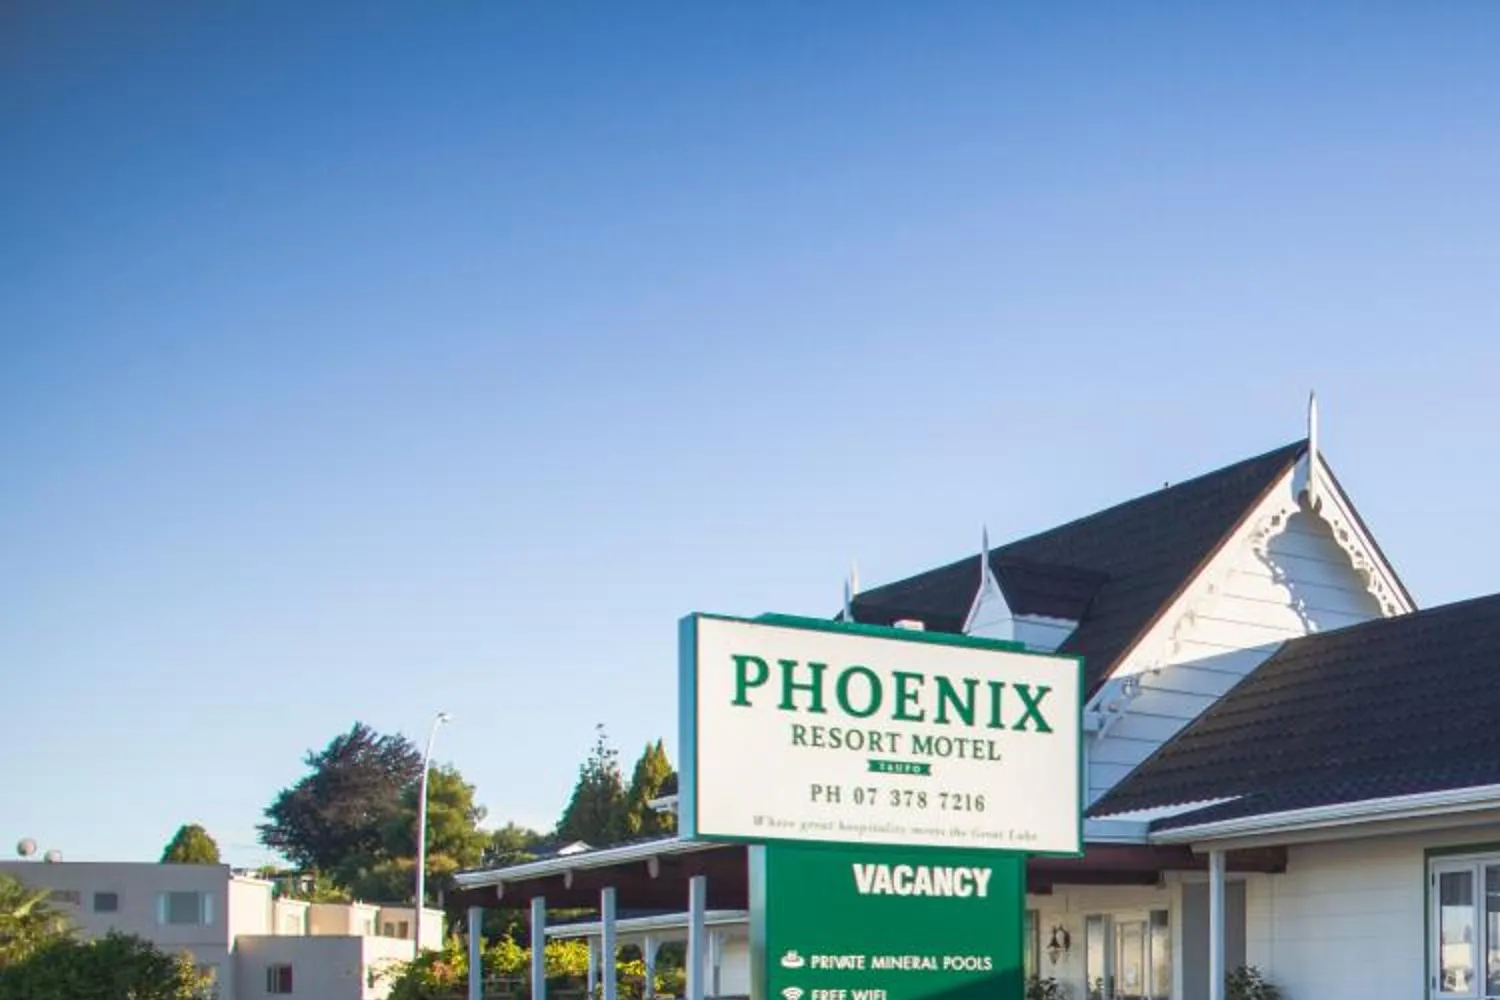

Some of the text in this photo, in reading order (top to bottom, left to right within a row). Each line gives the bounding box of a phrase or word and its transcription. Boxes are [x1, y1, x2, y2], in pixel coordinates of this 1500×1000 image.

[731, 653, 1054, 734] PHOENIX
[791, 724, 1002, 762] RESORT MOTEL
[811, 783, 986, 812] PH 07 378 7216
[852, 863, 992, 898] VACANCY
[811, 955, 993, 970] PRIVATE MINERAL POOLS
